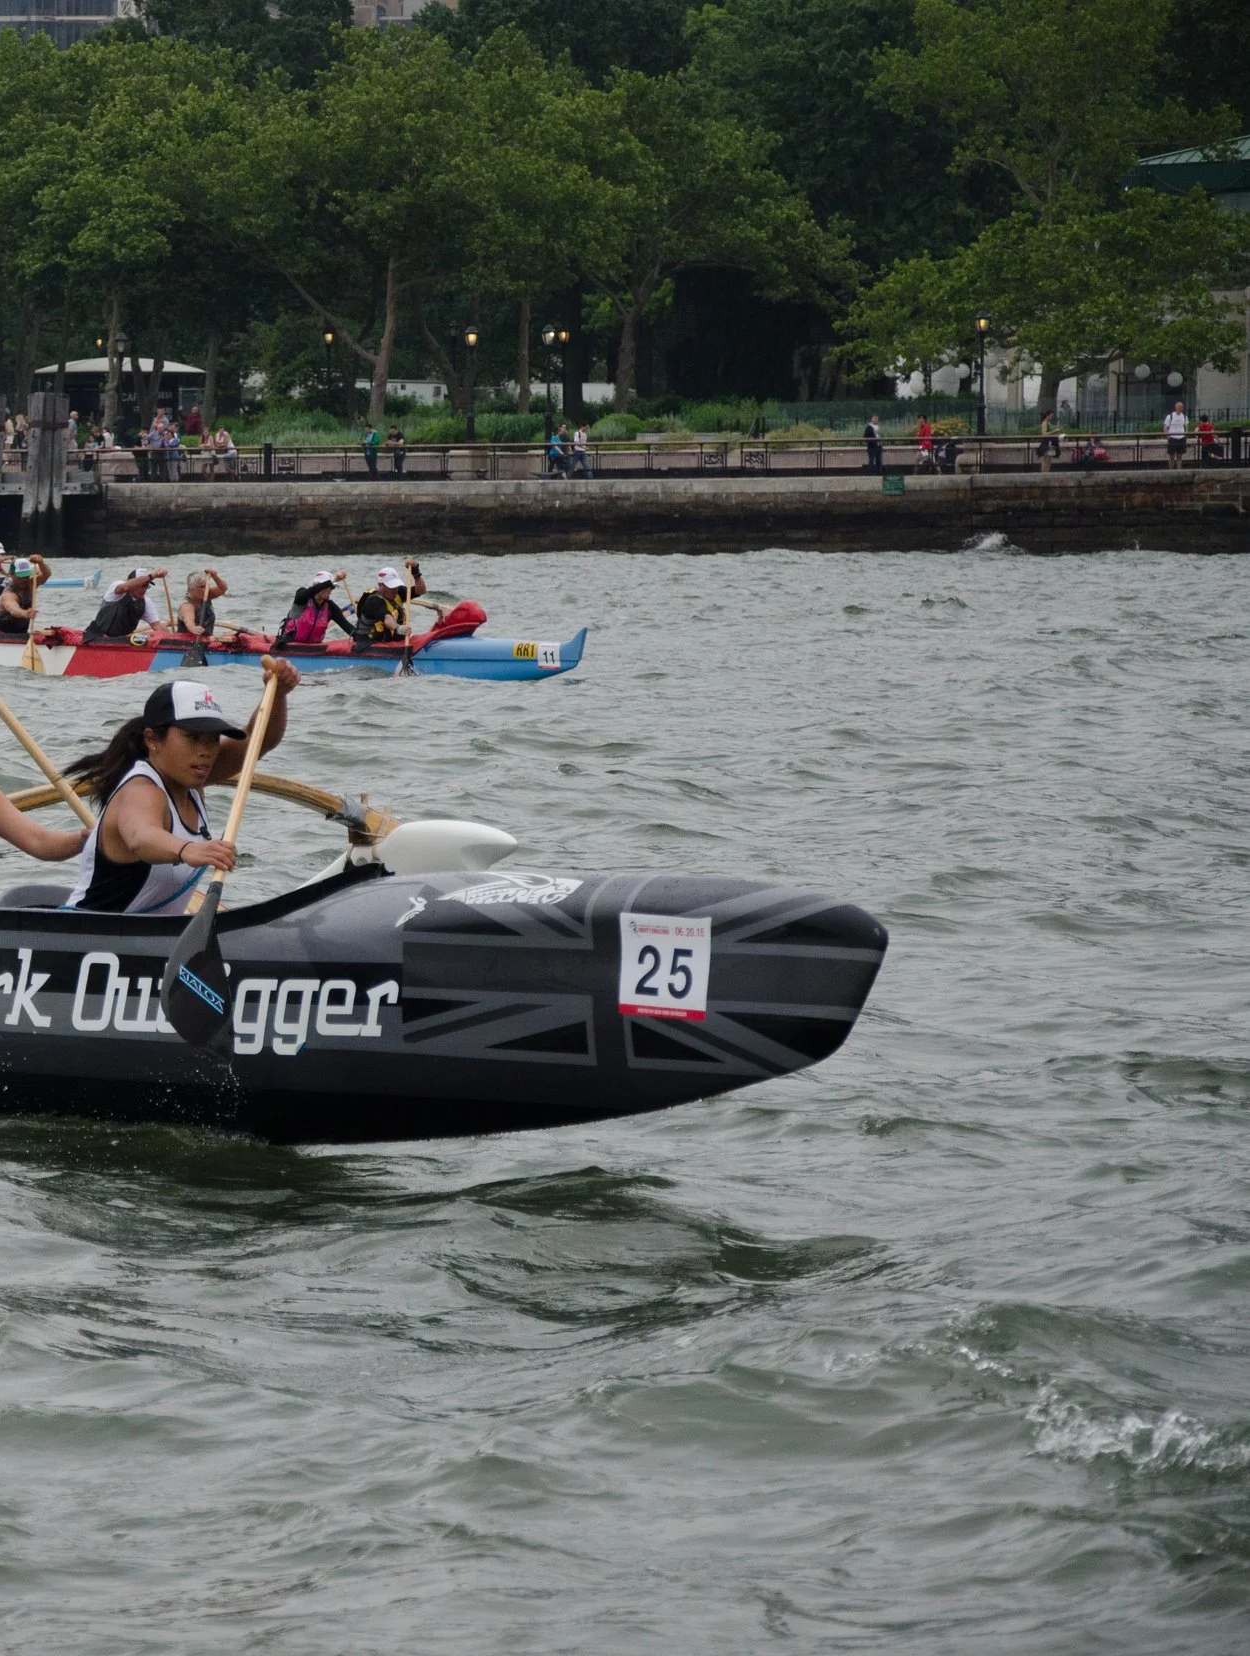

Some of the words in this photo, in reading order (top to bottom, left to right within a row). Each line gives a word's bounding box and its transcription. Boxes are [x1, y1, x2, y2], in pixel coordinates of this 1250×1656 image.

[542, 651, 555, 664] 11
[179, 967, 224, 1011] KIALOA
[635, 944, 693, 1000] 25
[72, 952, 400, 1056] Ougger
